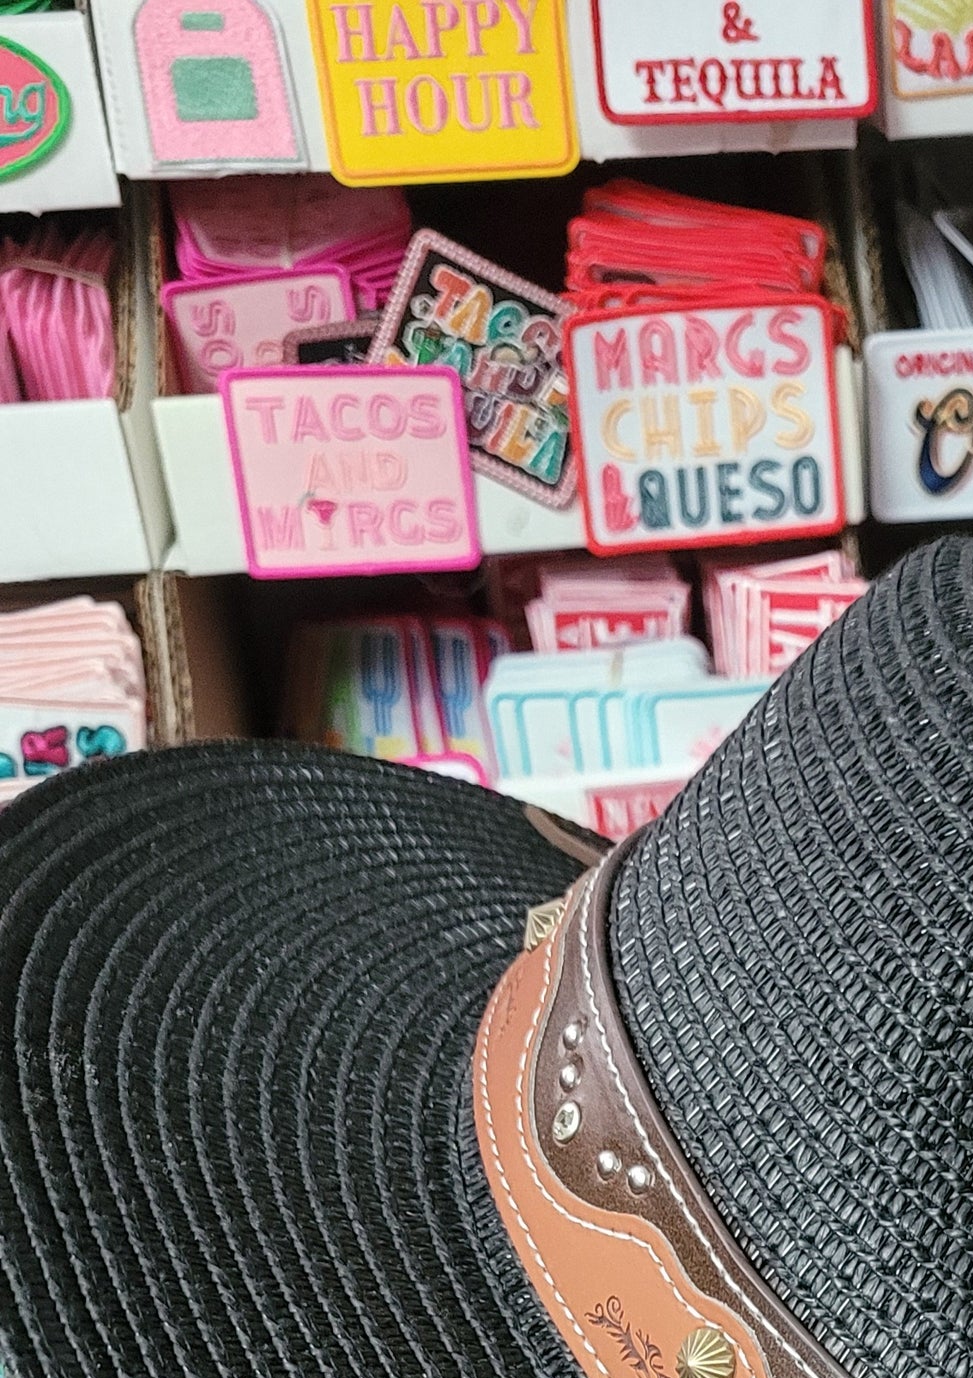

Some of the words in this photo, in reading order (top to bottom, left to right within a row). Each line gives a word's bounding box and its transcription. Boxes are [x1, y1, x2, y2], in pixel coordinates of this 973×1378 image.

[331, 0, 538, 62] HAPPY
[721, 1, 760, 43] &
[354, 71, 541, 137] HOUR
[635, 56, 847, 107] TEQUILA
[431, 264, 562, 352] TACO
[593, 308, 812, 393] MARGS
[245, 393, 447, 444] TACOS
[602, 380, 816, 464] CHIPS
[304, 451, 409, 492] AND
[638, 455, 821, 530] QUESO
[256, 498, 463, 551] MRGS
